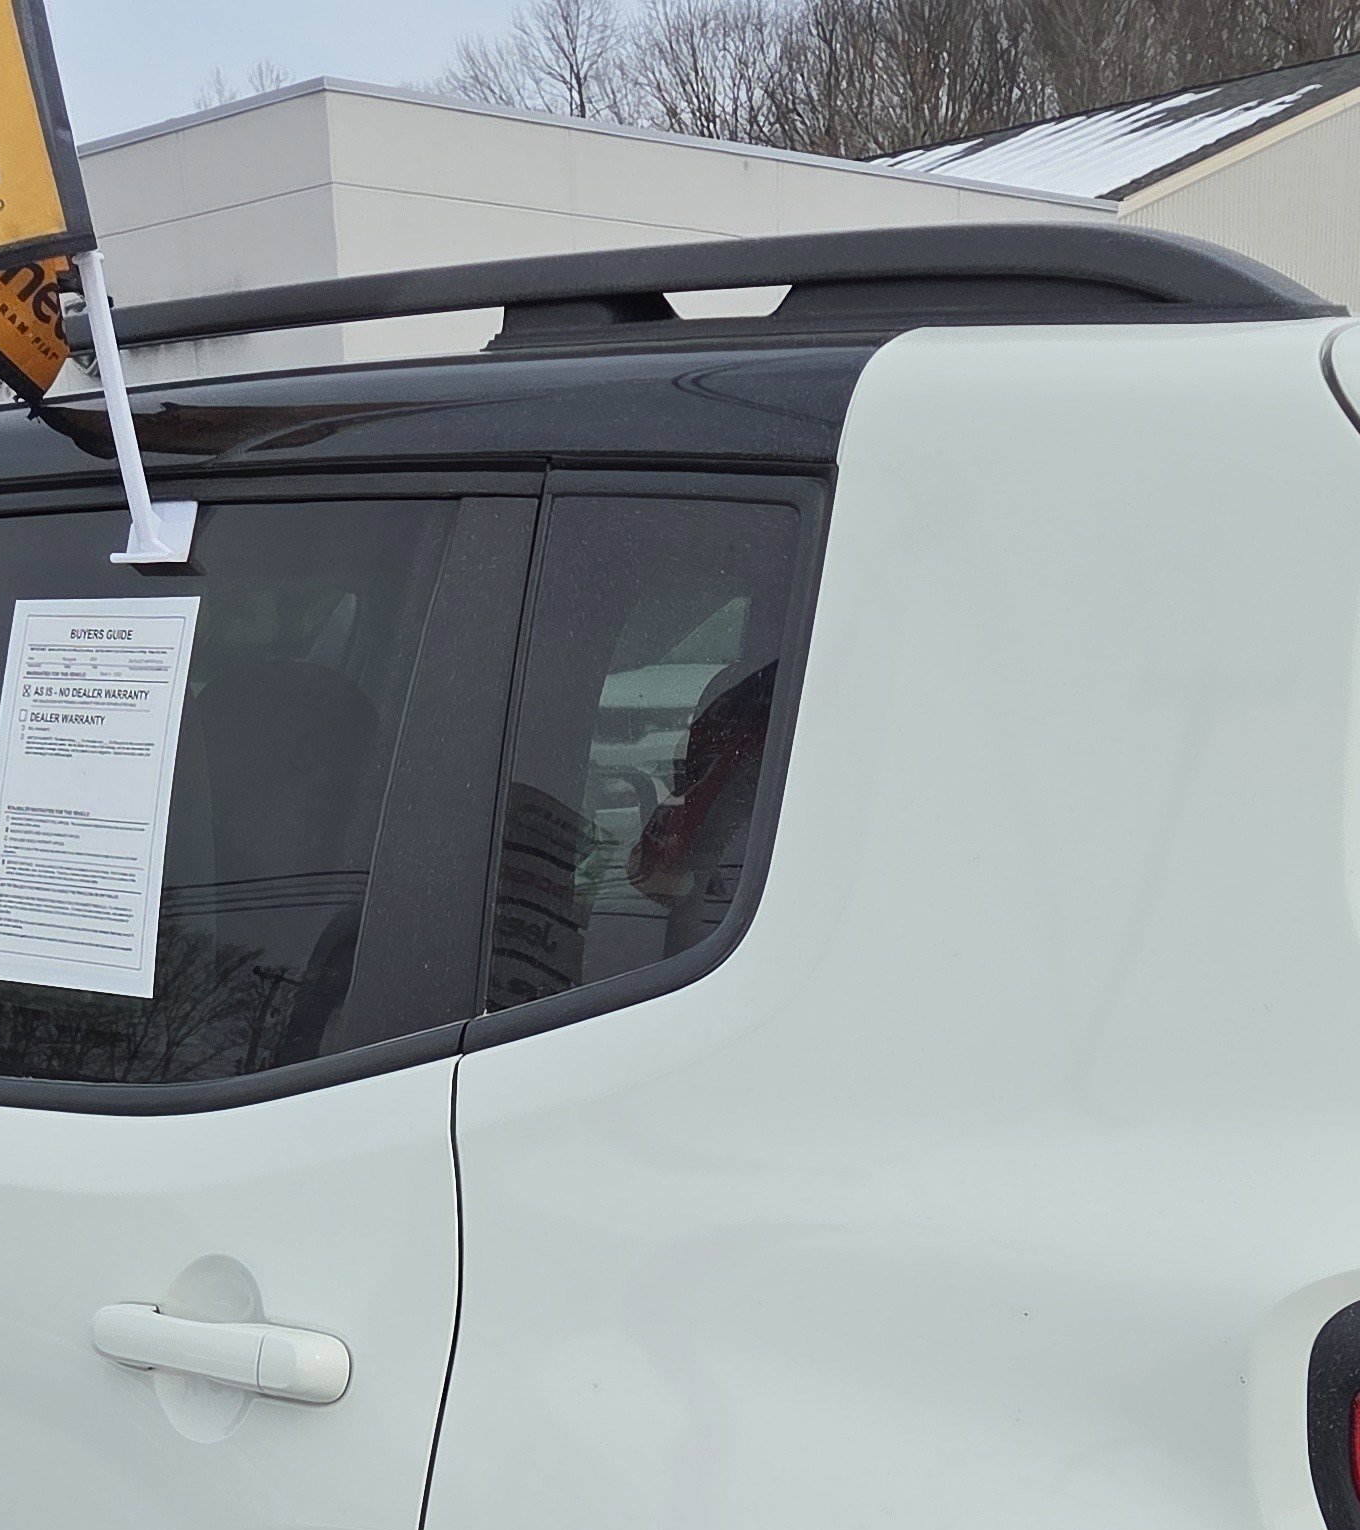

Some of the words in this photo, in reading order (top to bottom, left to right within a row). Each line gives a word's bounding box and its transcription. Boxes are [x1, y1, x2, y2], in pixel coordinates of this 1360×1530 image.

[70, 628, 104, 641] BUYERS
[106, 629, 134, 641] GUIDE
[33, 686, 44, 696] AS
[45, 687, 53, 697] IS
[59, 687, 71, 698] NO
[71, 688, 103, 699] DEALER
[104, 689, 150, 701] WARRANTY
[29, 712, 63, 723] DEALER
[62, 713, 106, 726] WARRANTY
